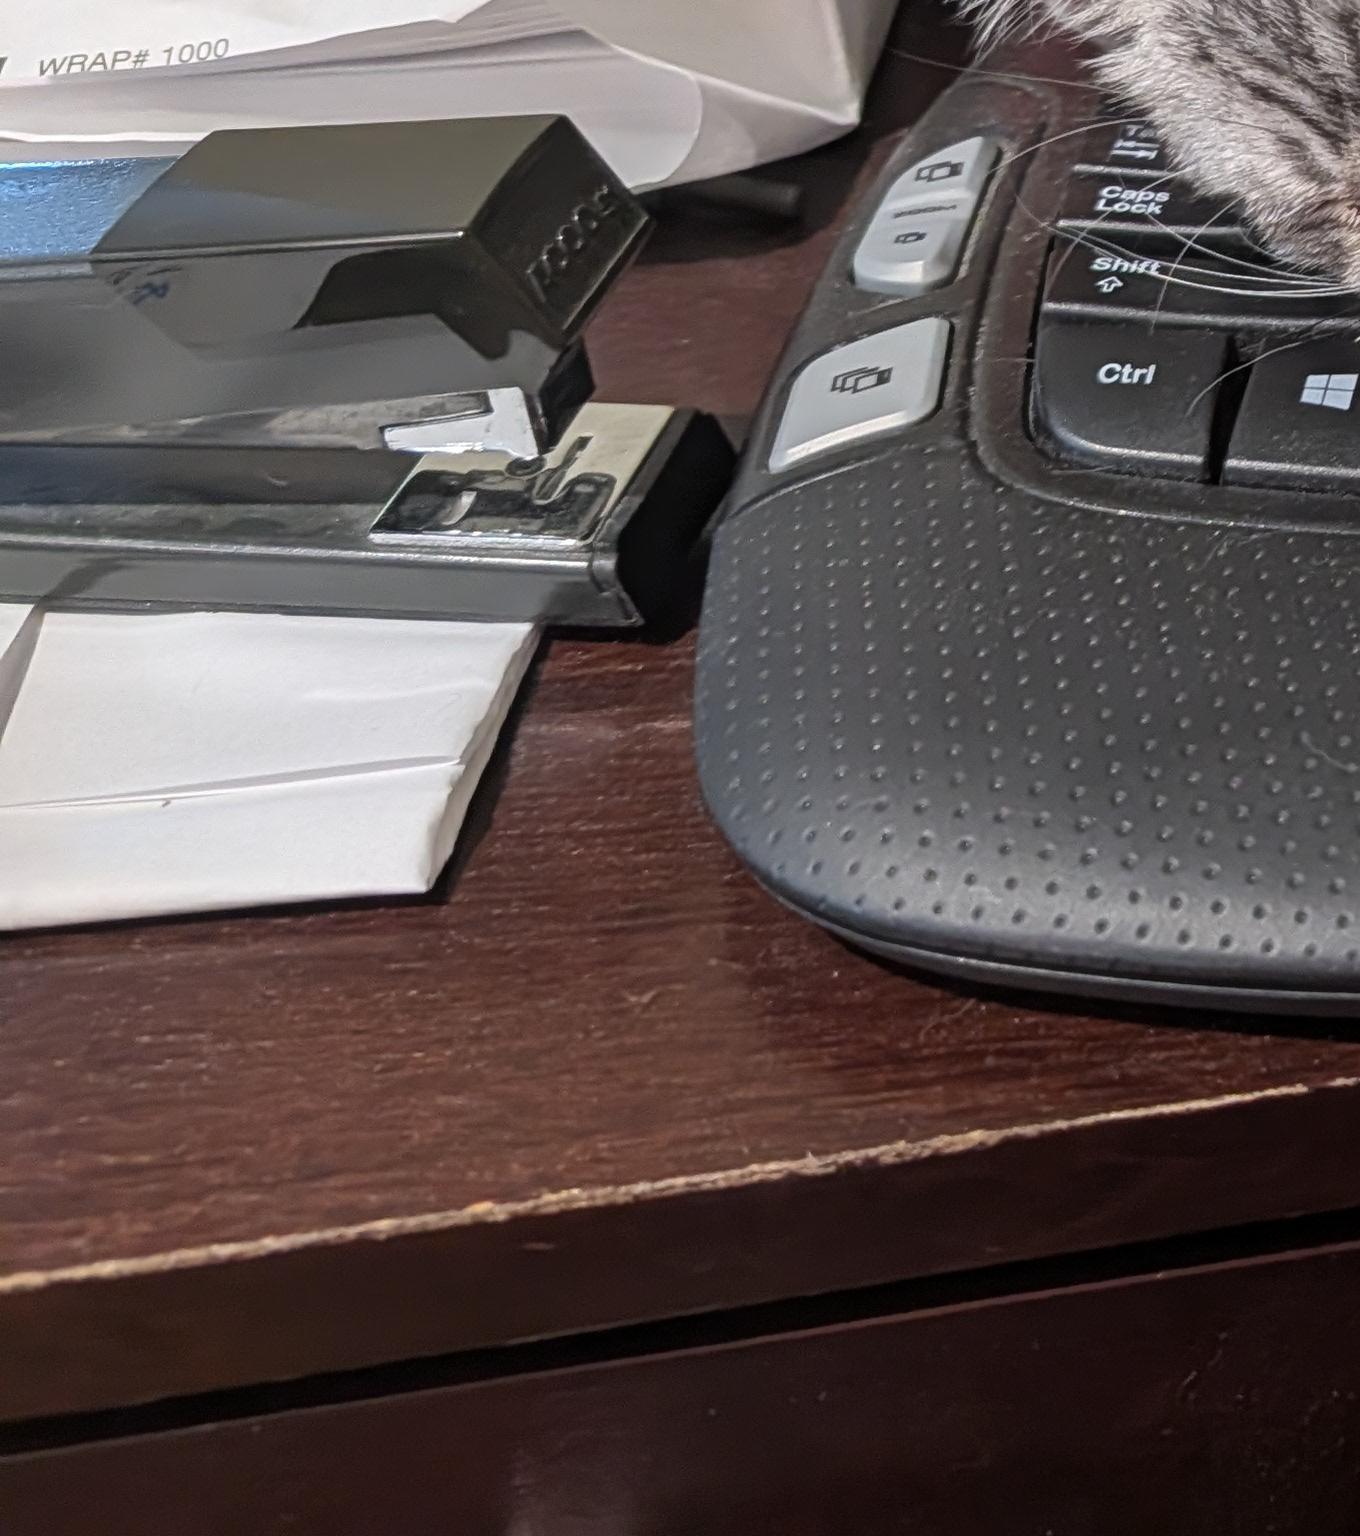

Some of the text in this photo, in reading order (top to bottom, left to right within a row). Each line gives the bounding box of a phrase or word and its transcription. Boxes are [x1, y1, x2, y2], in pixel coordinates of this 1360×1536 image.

[39, 38, 230, 77] WRAP# 1000
[1099, 185, 1170, 202] Caps
[1096, 199, 1164, 215] Lock
[1090, 257, 1162, 274] Shift
[1096, 359, 1155, 387] Ctrl
